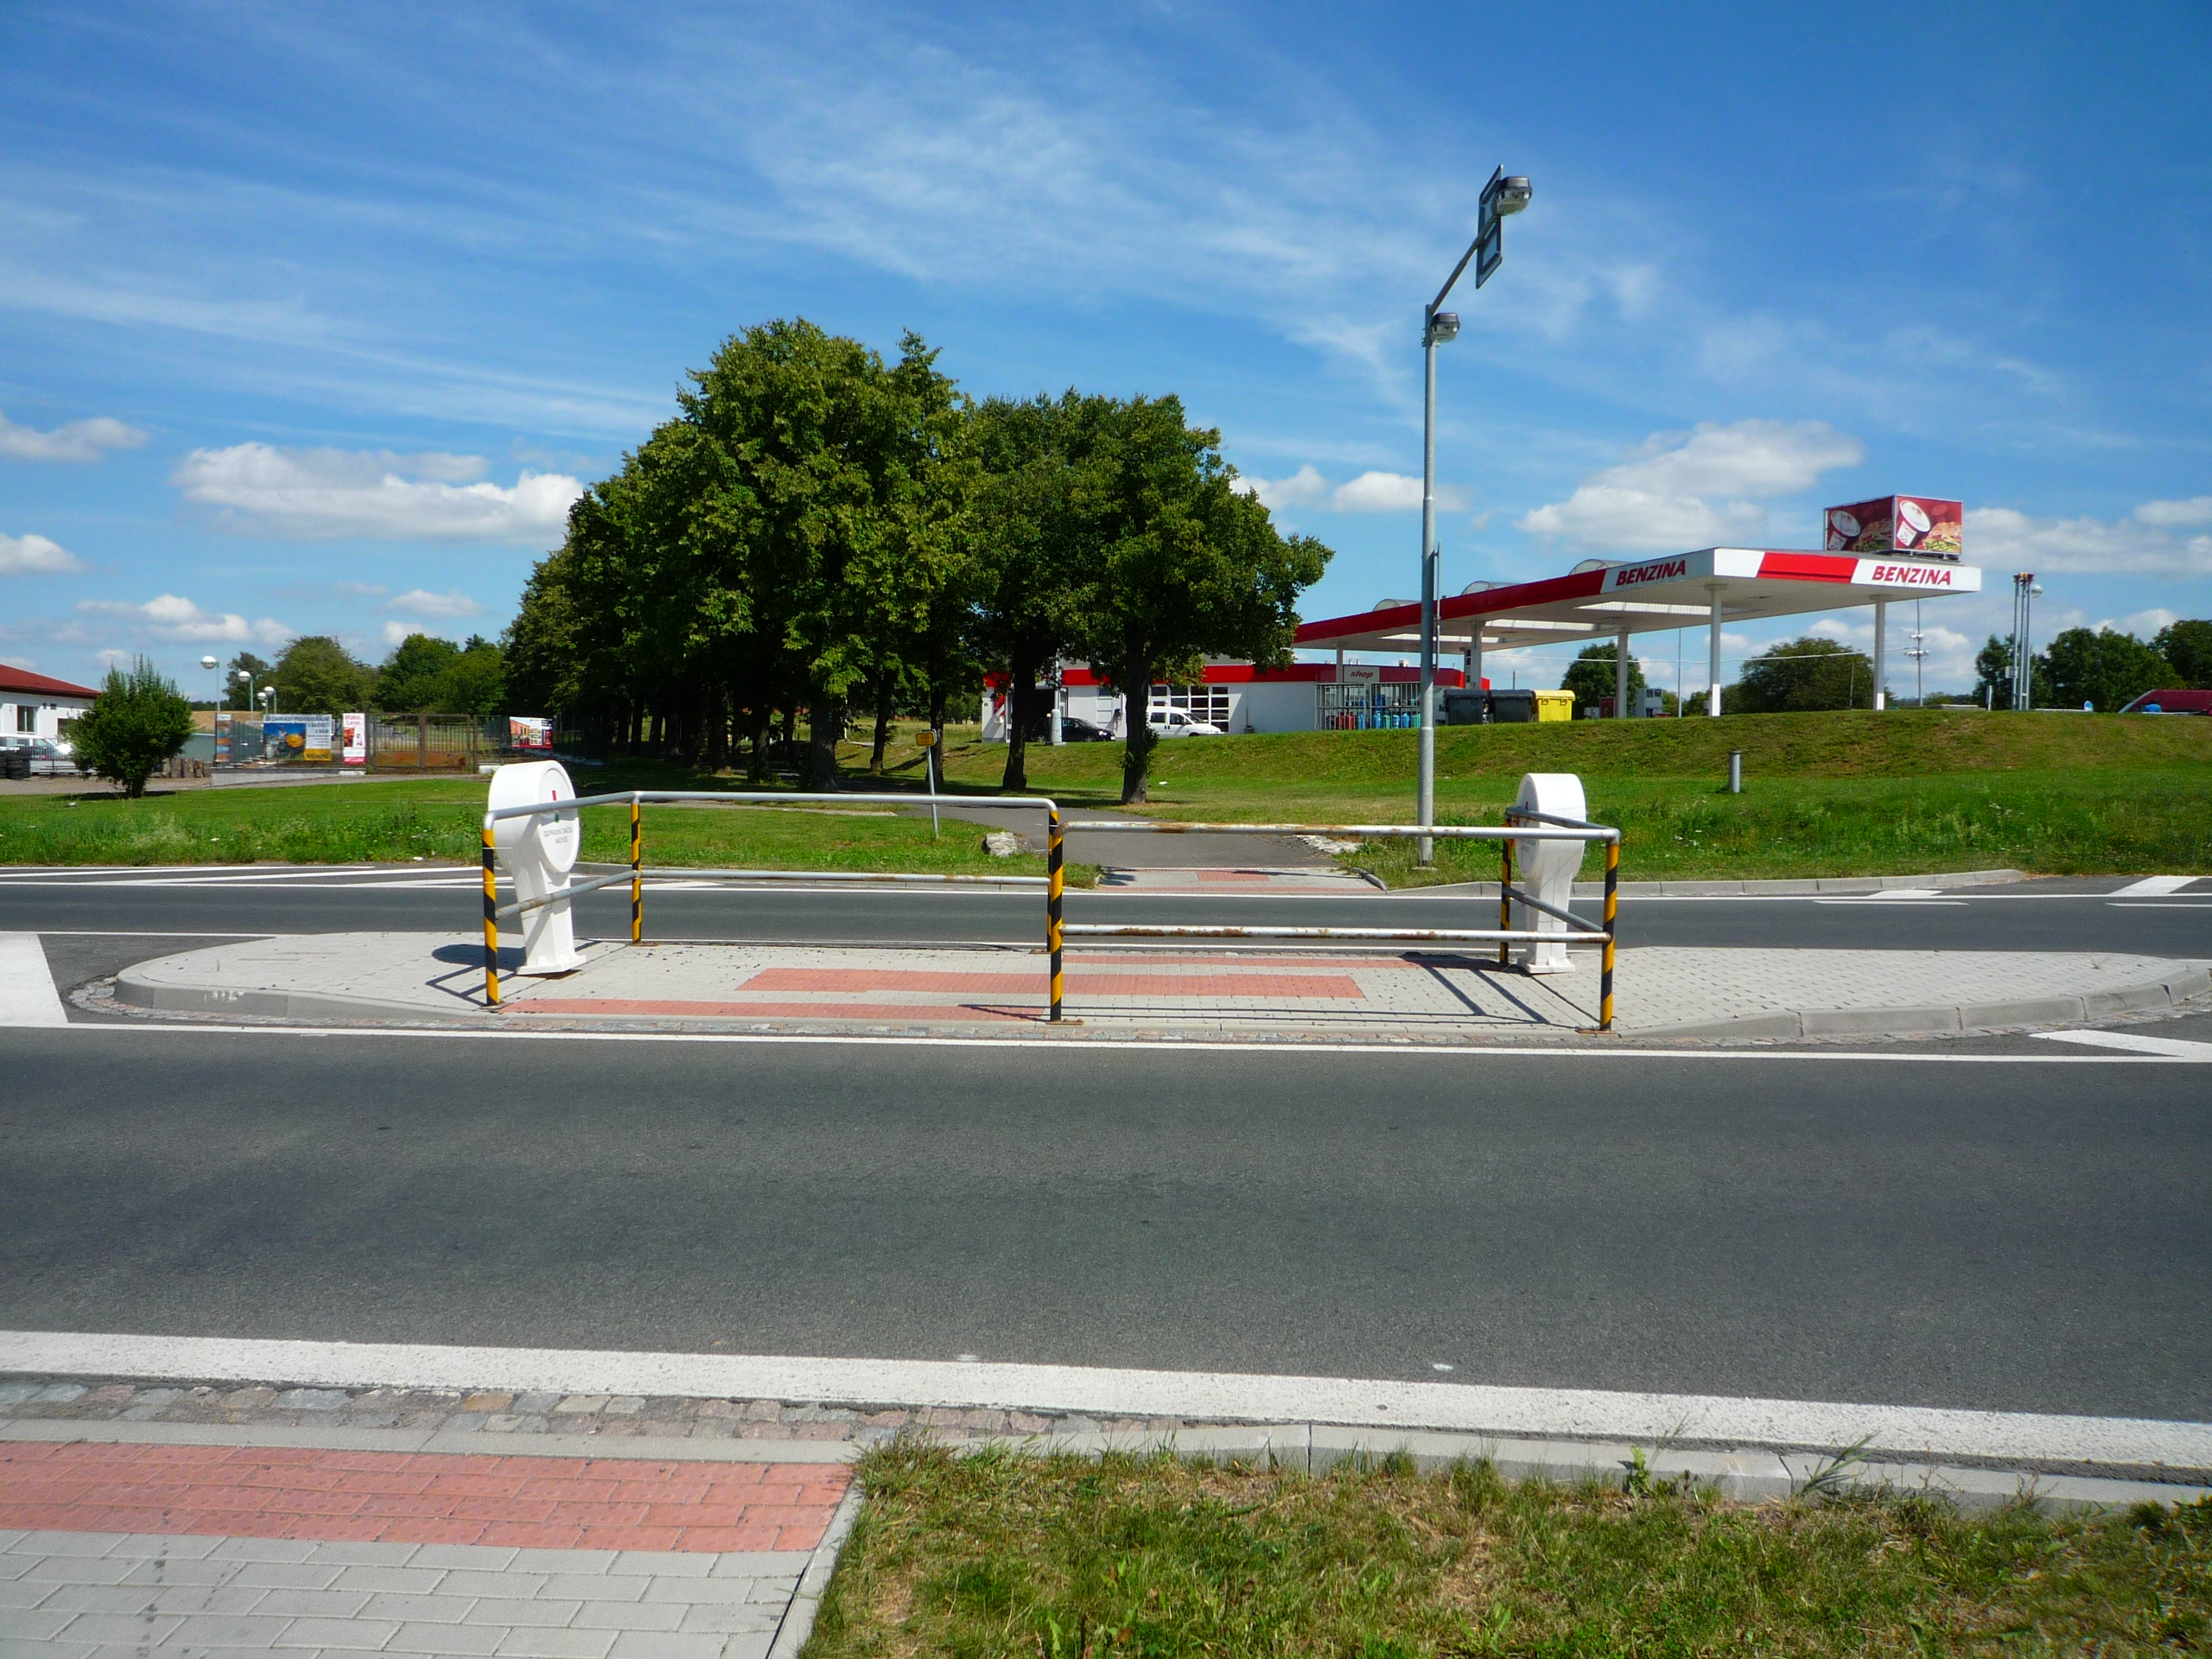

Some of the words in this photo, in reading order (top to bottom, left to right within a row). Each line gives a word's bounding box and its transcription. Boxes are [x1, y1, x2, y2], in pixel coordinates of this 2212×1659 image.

[1616, 560, 1686, 586] BENZINA
[1872, 565, 1952, 586] BENZINA
[1350, 671, 1374, 679] shop
